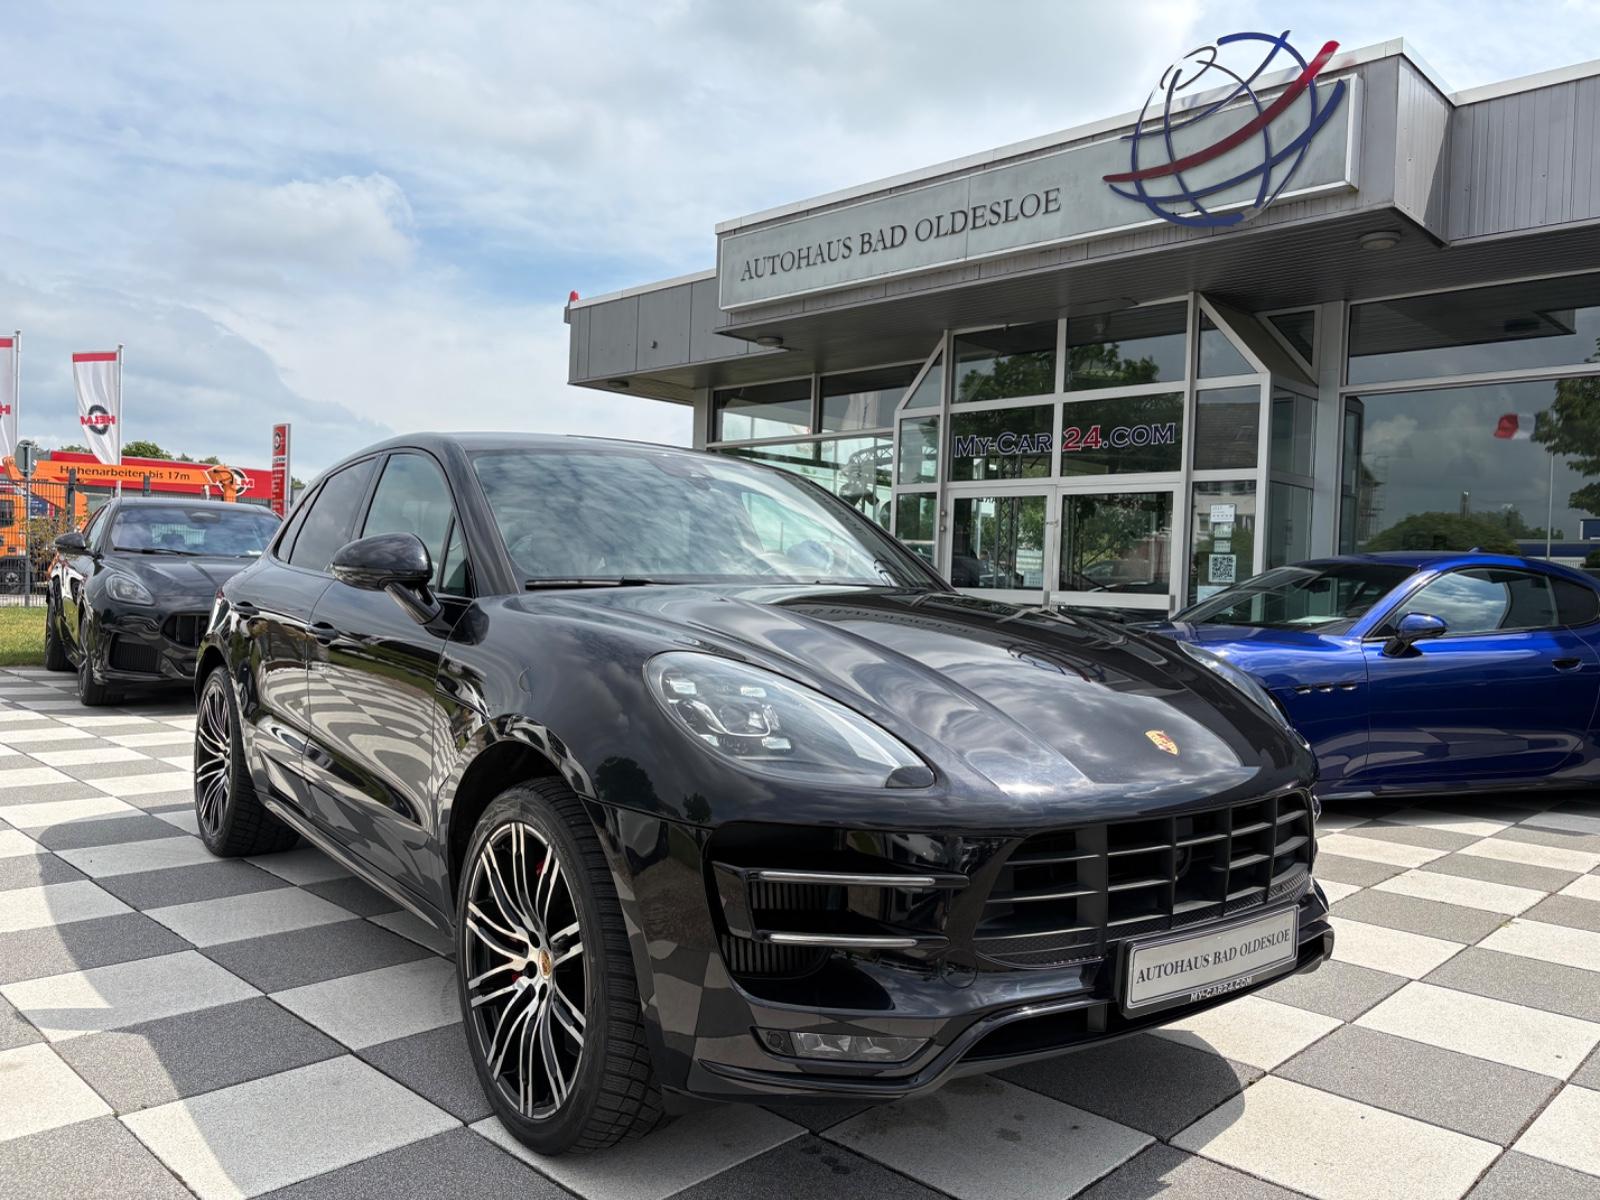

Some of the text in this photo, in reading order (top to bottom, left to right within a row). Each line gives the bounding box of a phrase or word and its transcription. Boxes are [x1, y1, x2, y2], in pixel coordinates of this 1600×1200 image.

[740, 187, 1063, 282] AUTOHAUS BAD OLDESLOE
[59, 465, 191, 481] Hhenarbeiten bis 17m
[1136, 928, 1291, 985] AUTOHAUS BAD OLDESLOE
